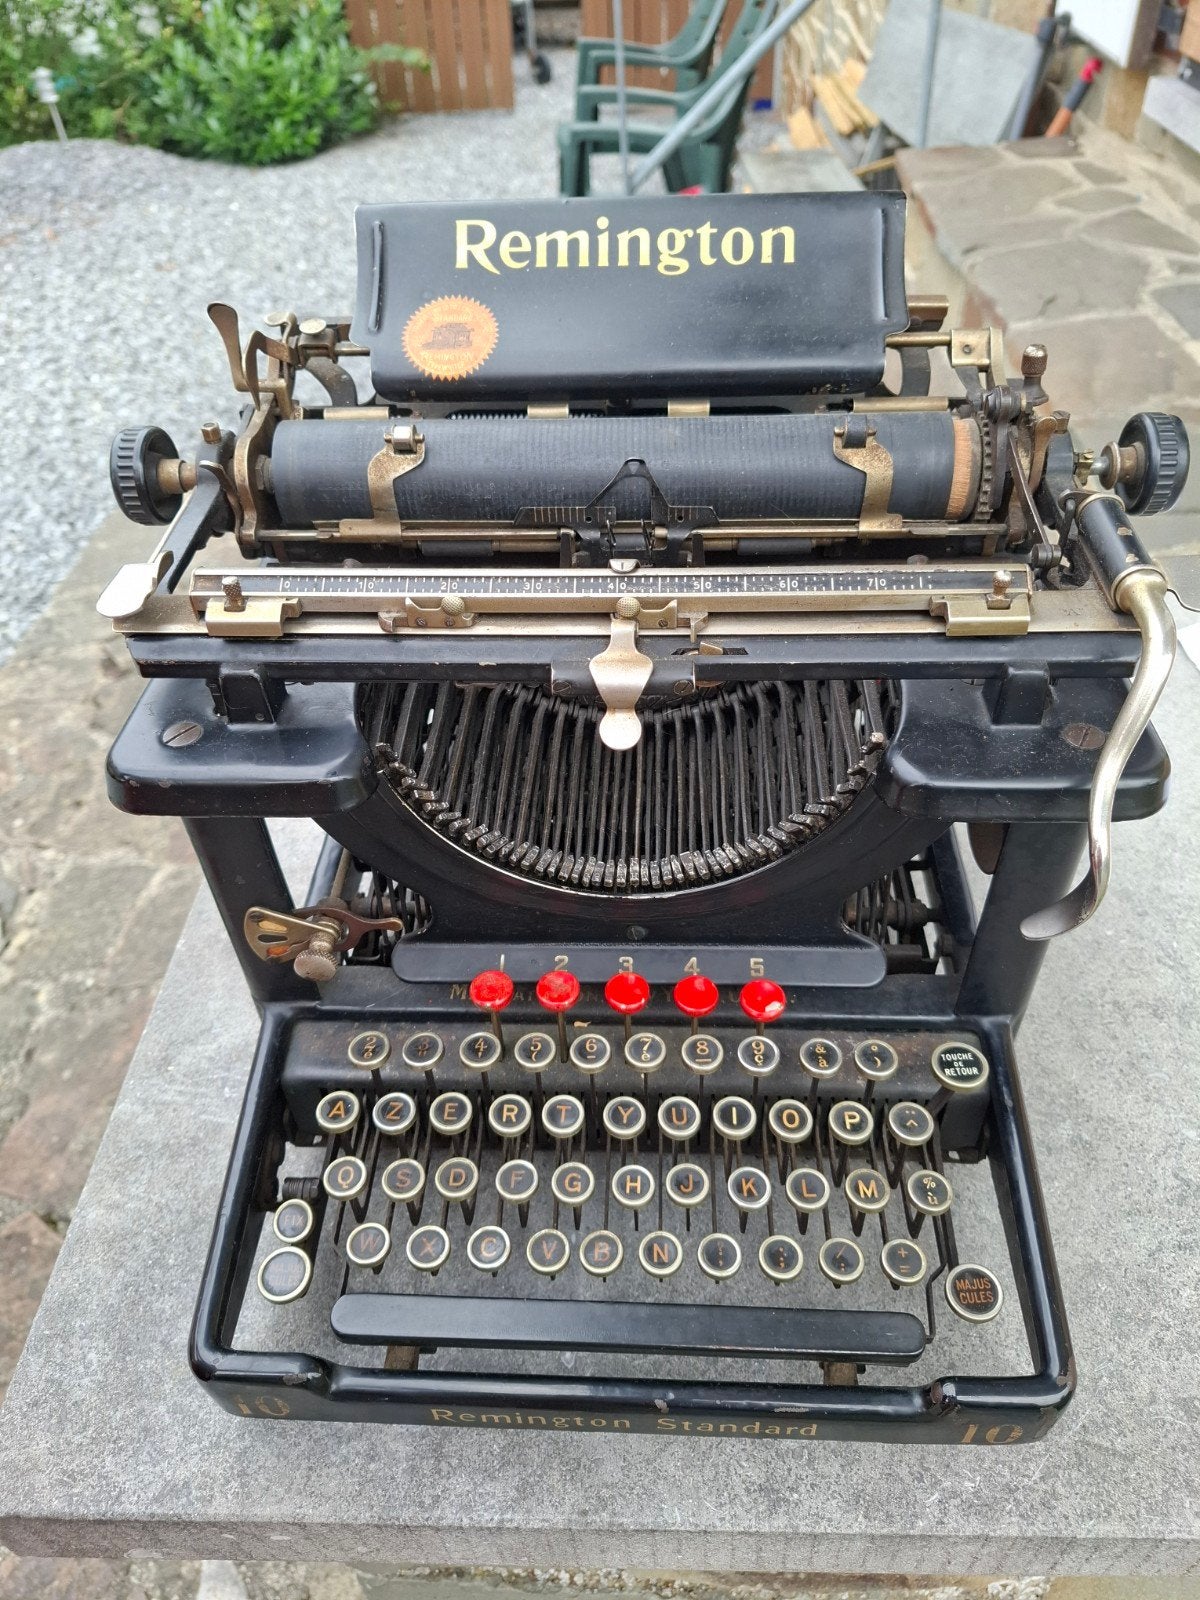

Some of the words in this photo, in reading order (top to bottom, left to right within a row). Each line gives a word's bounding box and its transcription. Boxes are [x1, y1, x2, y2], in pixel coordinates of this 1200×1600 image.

[455, 216, 796, 276] Remington
[284, 581, 291, 590] 0
[358, 581, 374, 590] 10
[440, 581, 458, 590] 20
[523, 581, 542, 590] 30
[607, 581, 627, 590] 40
[693, 580, 712, 590] 50
[779, 579, 798, 588] 60
[867, 577, 886, 587] 70
[500, 954, 505, 972] 1
[554, 955, 569, 971] 2
[618, 956, 634, 973] 3
[684, 957, 700, 976] 4
[750, 957, 765, 977] 5
[530, 1038, 542, 1051] 5
[585, 1039, 597, 1052] 6
[639, 1038, 652, 1051] 7
[696, 1041, 709, 1055] 8
[751, 1041, 765, 1055] 9
[941, 1052, 974, 1062] TOUCHE
[944, 1067, 979, 1077] RETOUR
[329, 1100, 346, 1119] A
[386, 1102, 404, 1120] Z
[443, 1103, 459, 1120] E
[502, 1104, 518, 1123] R
[556, 1105, 571, 1124] T
[617, 1105, 634, 1124] Y
[671, 1107, 687, 1126] U
[731, 1106, 737, 1125] I
[782, 1109, 800, 1128] O
[844, 1111, 861, 1130] P
[337, 1165, 355, 1189] Q
[396, 1168, 411, 1187] S
[449, 1168, 466, 1187] D
[510, 1170, 525, 1189] F
[564, 1172, 581, 1192] G
[625, 1174, 641, 1194] H
[680, 1174, 694, 1193] J
[741, 1177, 758, 1198] K
[801, 1179, 817, 1198] L
[857, 1179, 878, 1199] M
[283, 1214, 304, 1227] FIX
[359, 1231, 381, 1253] W
[419, 1236, 437, 1257] X
[480, 1237, 497, 1258] C
[541, 1240, 558, 1260] V
[594, 1241, 610, 1262] B
[653, 1243, 669, 1263] N
[956, 1278, 991, 1290] MAJUS
[959, 1291, 994, 1304] CULES
[234, 1396, 289, 1416] 10
[430, 1408, 631, 1429] Remington
[656, 1417, 818, 1437] Standard
[961, 1423, 1023, 1444] 10
